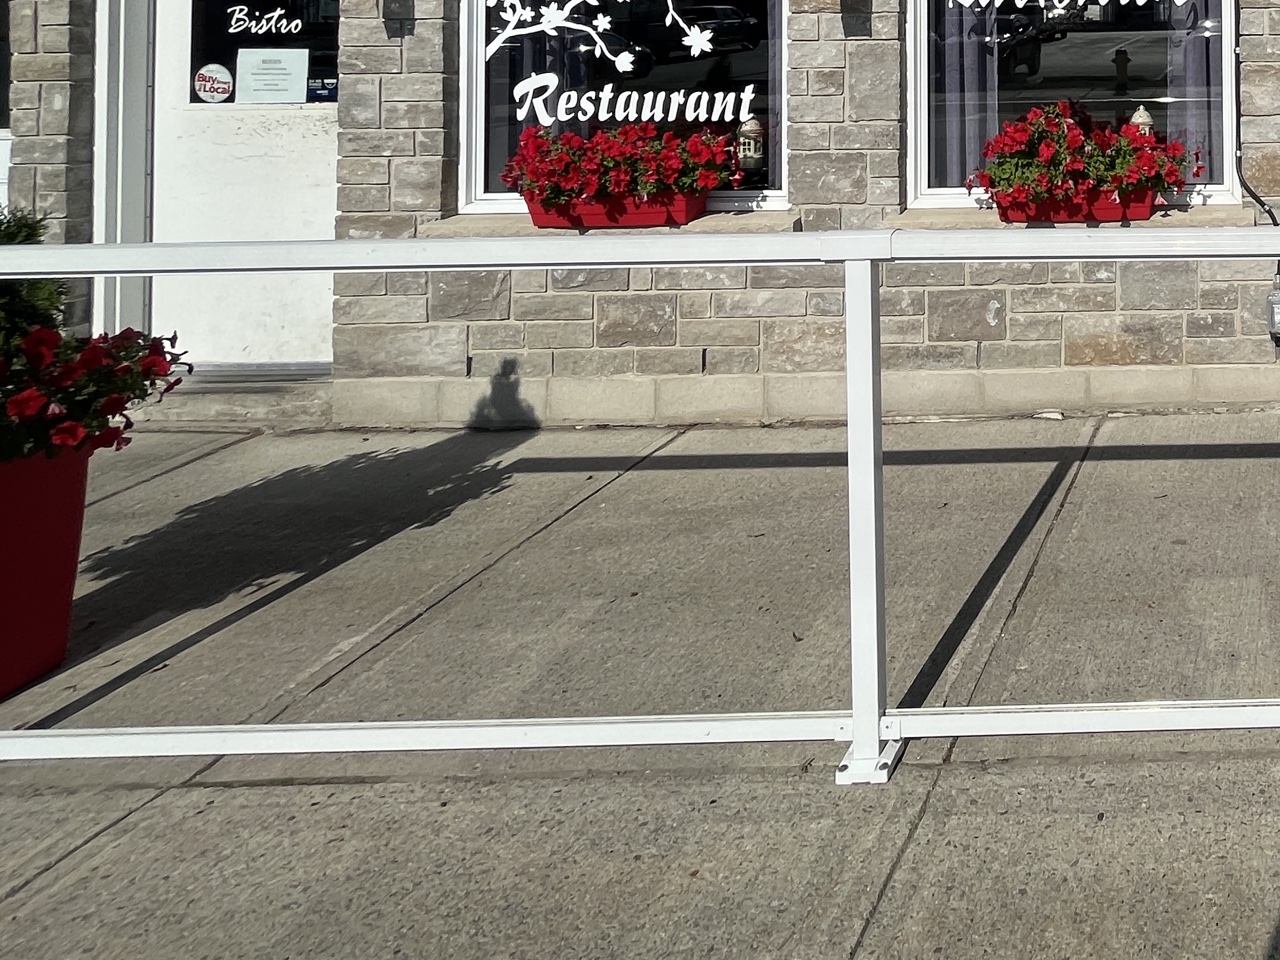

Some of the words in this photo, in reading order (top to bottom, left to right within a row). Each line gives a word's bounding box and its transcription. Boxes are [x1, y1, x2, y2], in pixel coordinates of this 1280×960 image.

[226, 5, 302, 35] Bistro
[197, 73, 217, 86] Buy
[203, 83, 230, 95] Local
[513, 71, 756, 126] Restaurant
